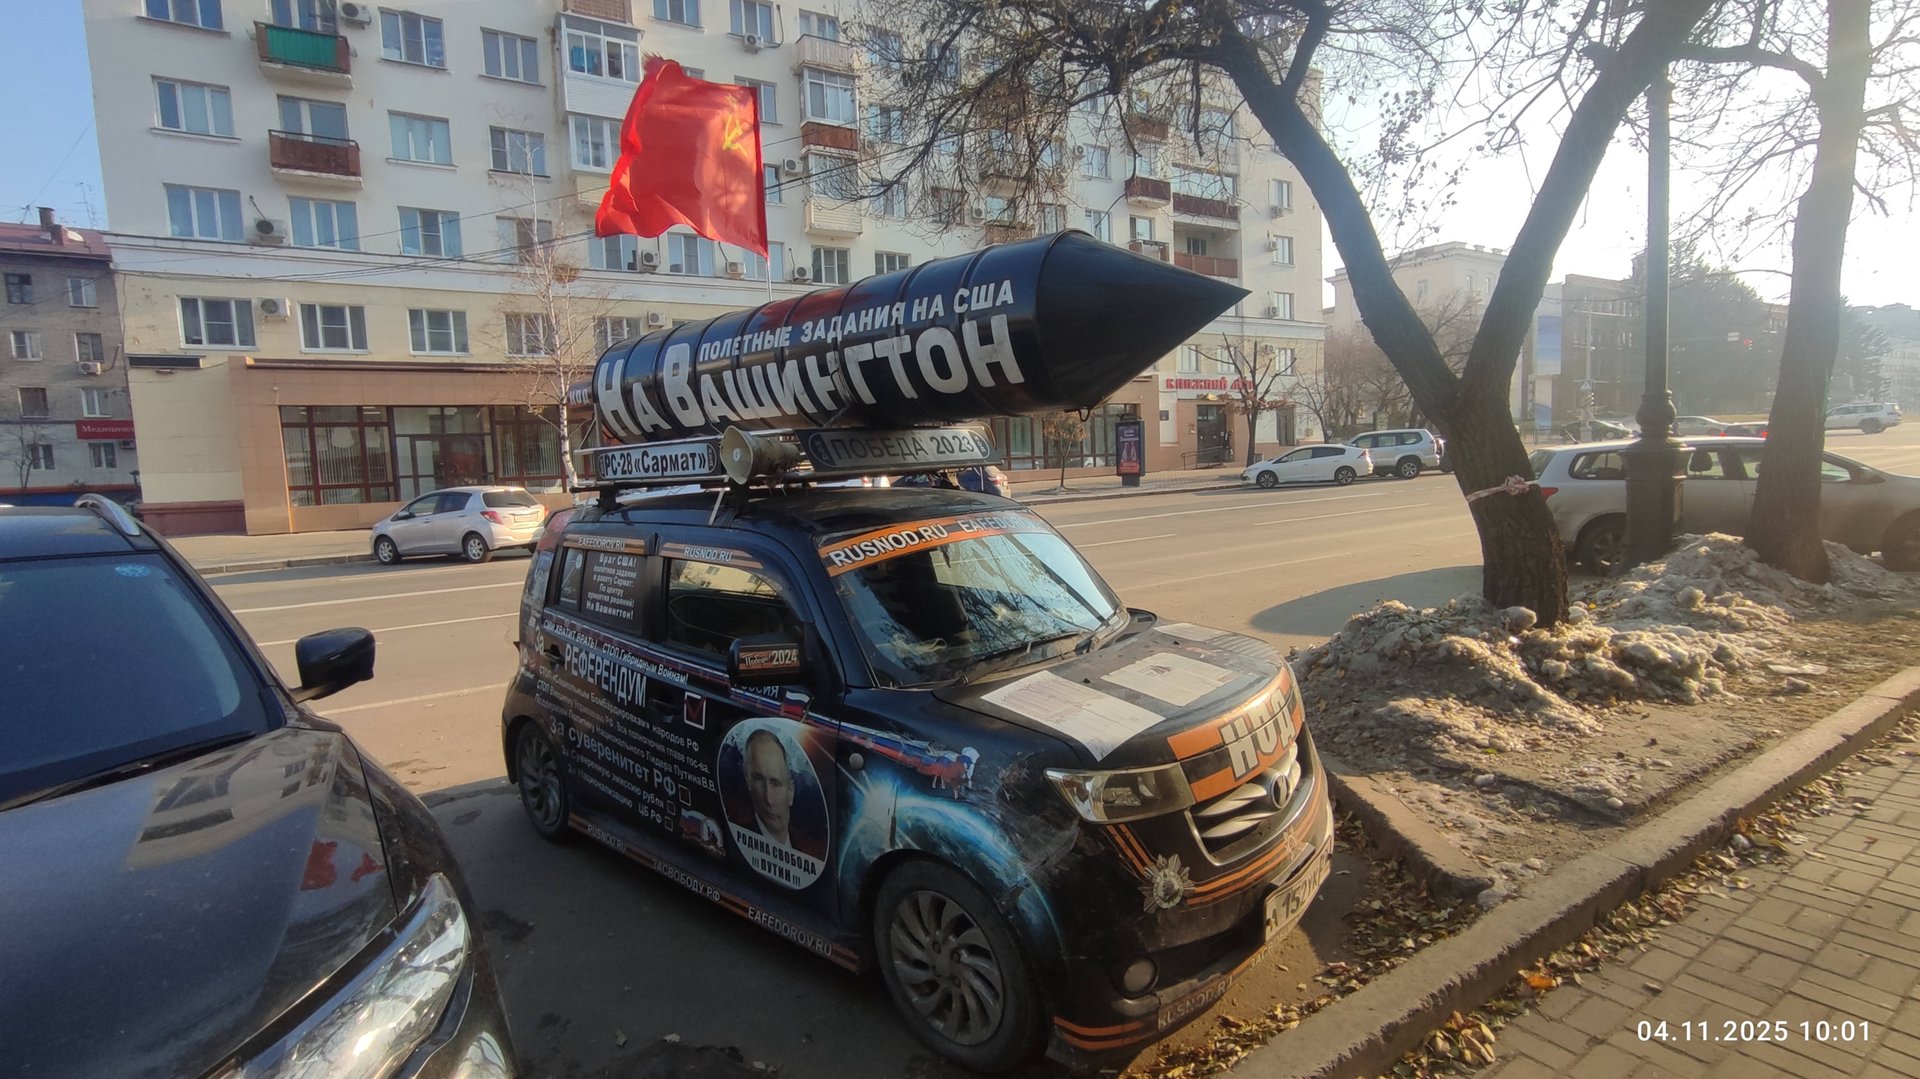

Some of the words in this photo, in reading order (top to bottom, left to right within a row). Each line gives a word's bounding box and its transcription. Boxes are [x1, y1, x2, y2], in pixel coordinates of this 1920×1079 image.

[699, 326, 792, 363] ПОЛЕТНЫЕ
[801, 301, 904, 342] ЗАДАНИЯ
[912, 296, 945, 323] НА
[953, 279, 1015, 315] США
[830, 437, 929, 461] ПОБЕДА
[931, 434, 975, 455] 2023
[604, 452, 633, 476] РС-28
[634, 450, 706, 476] «Сармат»
[578, 537, 626, 551] EAFEDOROV.RU
[684, 547, 733, 562] RUSNOD.RU
[828, 522, 950, 568] RUSNOD.RU
[617, 555, 637, 567] США!
[586, 600, 594, 610] На
[595, 602, 634, 620] Вашингтон!
[602, 642, 618, 657] СТОП
[618, 649, 657, 673] Гибридным
[657, 664, 688, 684] Войнам!
[772, 649, 798, 665] 2024
[564, 644, 648, 708] РЕФЕРЕНДУМ
[653, 724, 684, 748] народов
[687, 737, 700, 752] РФ
[1219, 688, 1297, 778] НОД
[549, 715, 565, 737] За
[568, 727, 650, 783] суверенитет
[653, 768, 677, 796] РФ
[674, 764, 701, 786] Путина
[701, 776, 718, 793] В.В.
[638, 802, 650, 817] ЦБ
[650, 809, 662, 824] РФ
[642, 790, 665, 809] рубля
[736, 830, 771, 856] РОДИНА
[772, 846, 817, 876] СВОБОДА
[761, 858, 791, 883] ПУТИН
[748, 905, 832, 957] EAFEDOROV.RU
